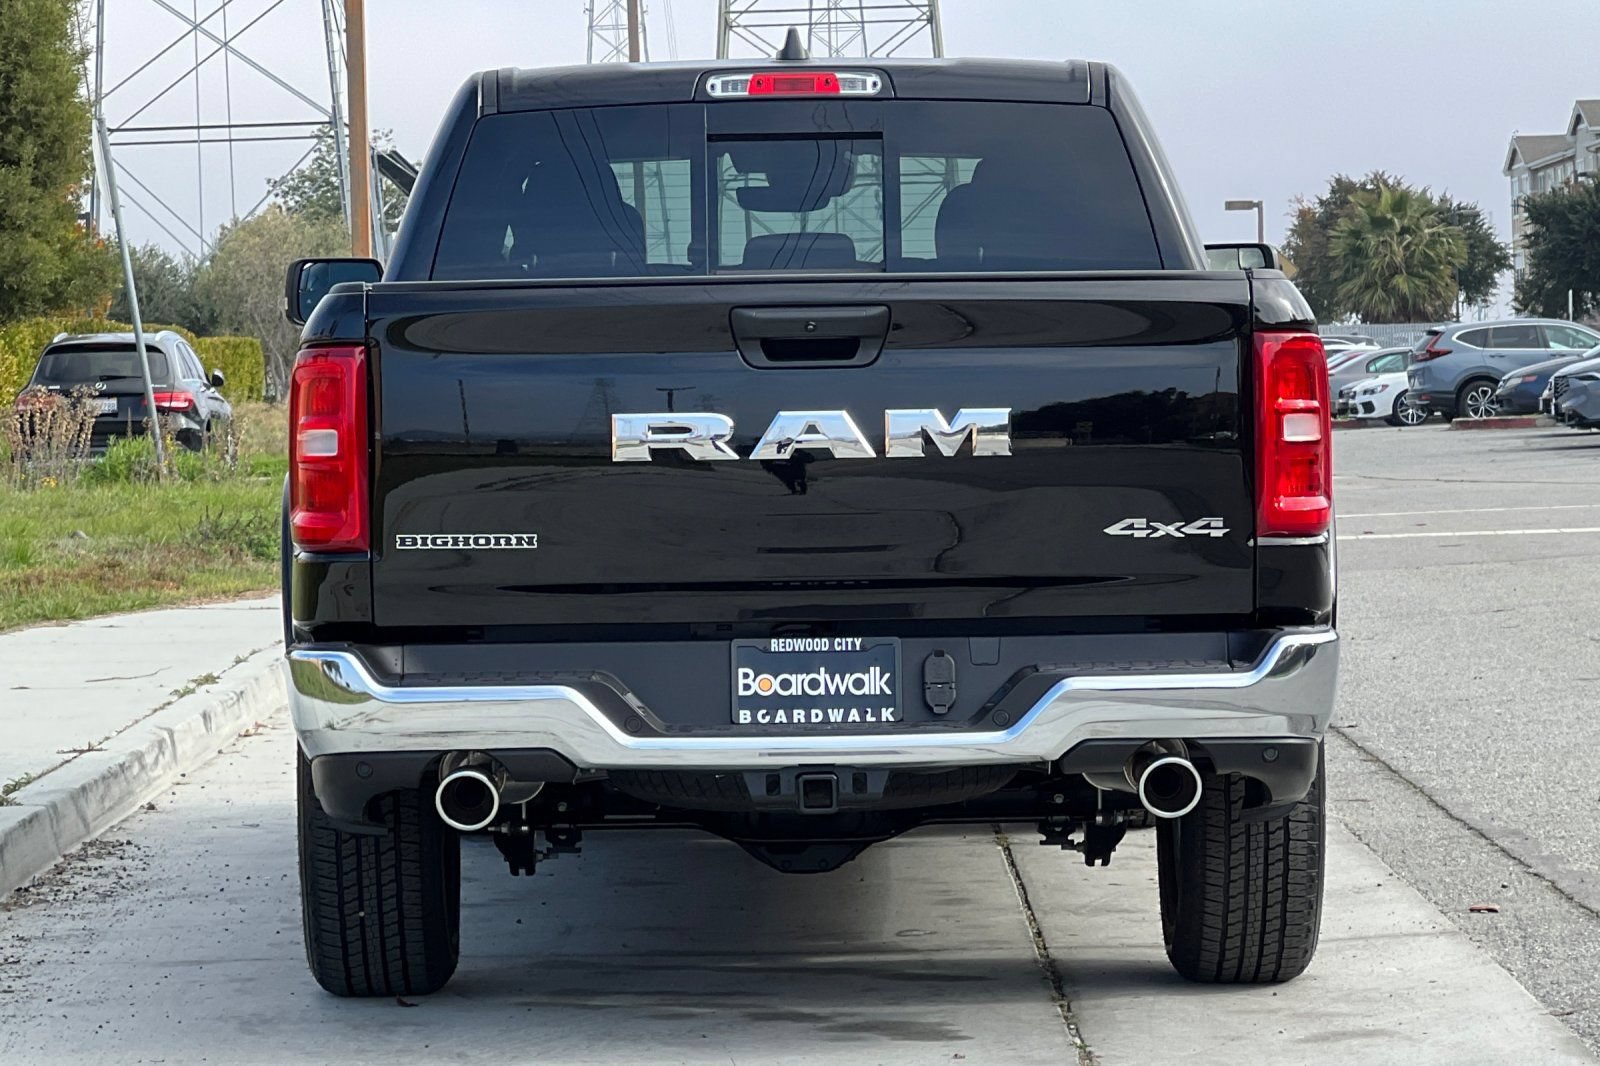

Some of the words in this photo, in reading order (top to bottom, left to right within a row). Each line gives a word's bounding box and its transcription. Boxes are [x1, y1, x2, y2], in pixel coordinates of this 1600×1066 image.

[611, 408, 1012, 462] RAM
[1103, 517, 1230, 538] 4x4
[396, 534, 537, 549] BIGHORN
[770, 637, 829, 652] REDWOOD
[834, 637, 862, 651] CITY
[737, 667, 892, 696] Boardwalk
[739, 707, 895, 724] BOARDWALK
